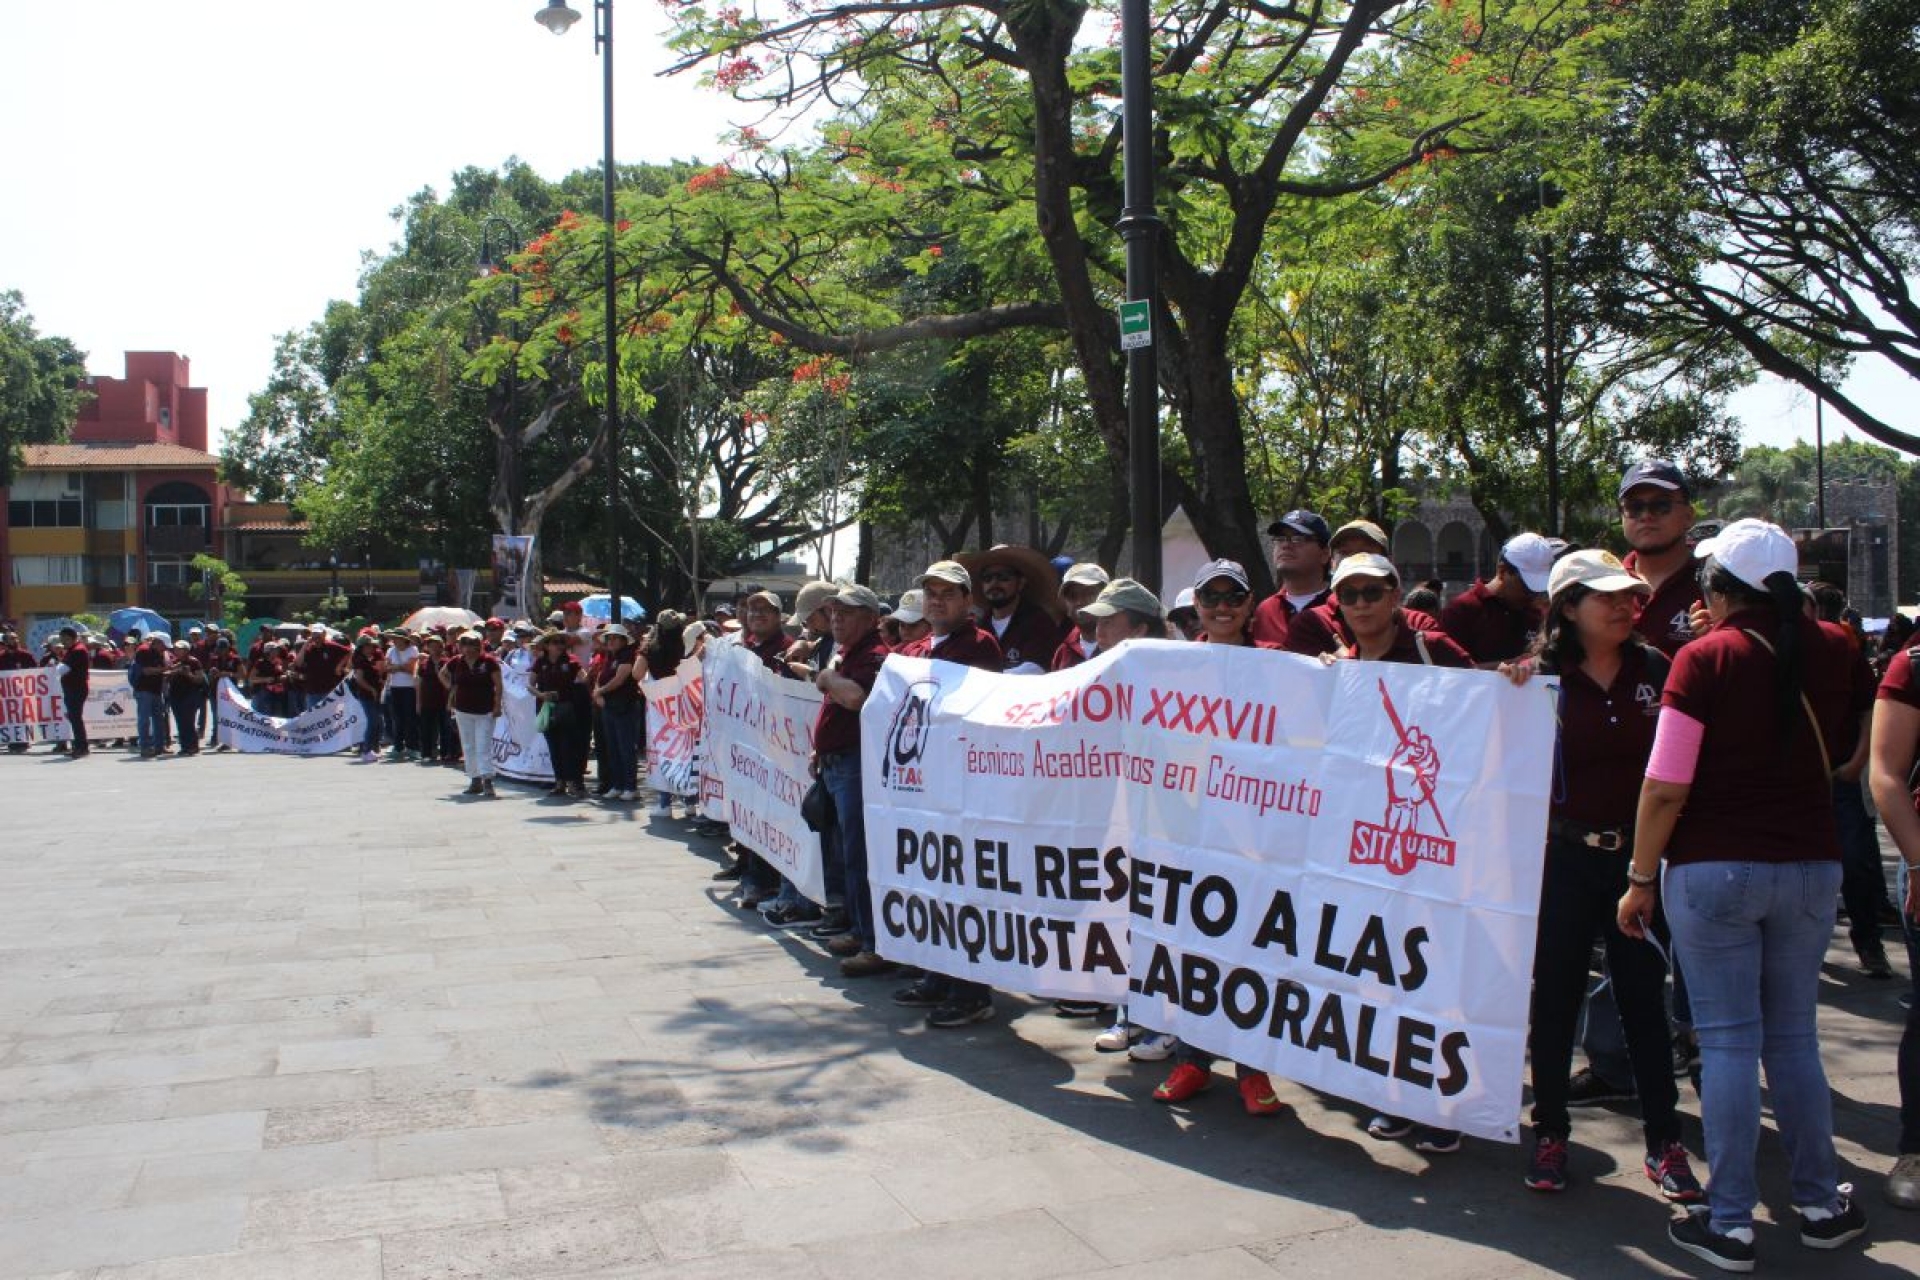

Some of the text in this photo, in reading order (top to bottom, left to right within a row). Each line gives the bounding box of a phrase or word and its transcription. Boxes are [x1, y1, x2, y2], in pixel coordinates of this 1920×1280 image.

[1142, 687, 1277, 745] XXXVII
[958, 736, 1025, 777] écnicos
[1163, 762, 1196, 793] en
[1206, 754, 1322, 817] Cómputo
[882, 889, 1131, 976] CONQUISTA
[897, 828, 1430, 992] POR EL RESETO A LAS
